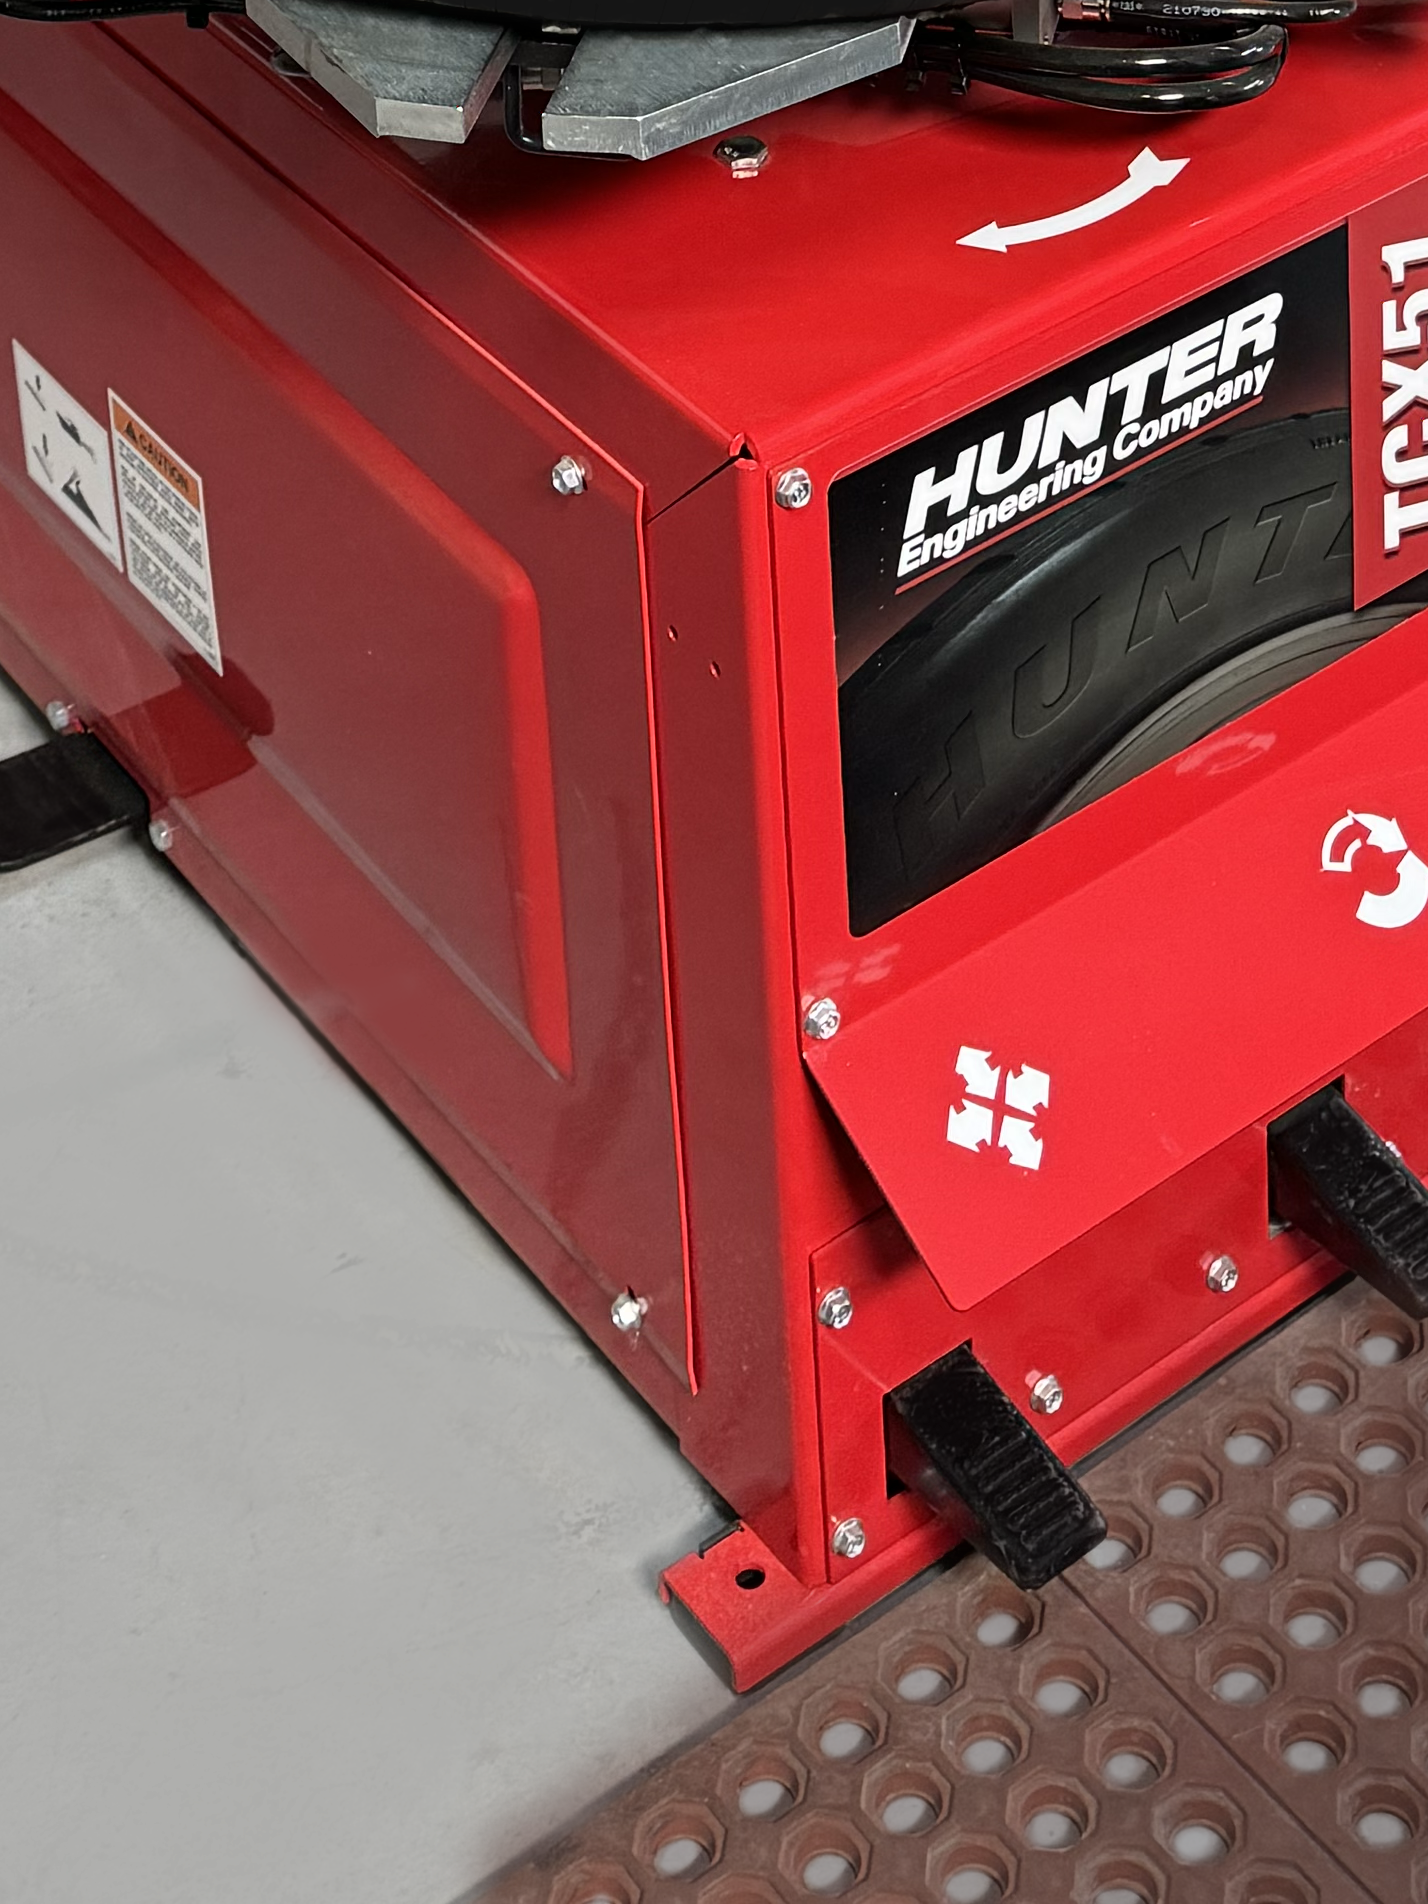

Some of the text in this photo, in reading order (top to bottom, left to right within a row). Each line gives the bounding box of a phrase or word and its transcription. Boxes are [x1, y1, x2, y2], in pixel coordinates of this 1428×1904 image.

[137, 433, 189, 492] CAUTION
[896, 356, 1273, 576] Engineering Company
[903, 292, 1283, 542] HUNTER
